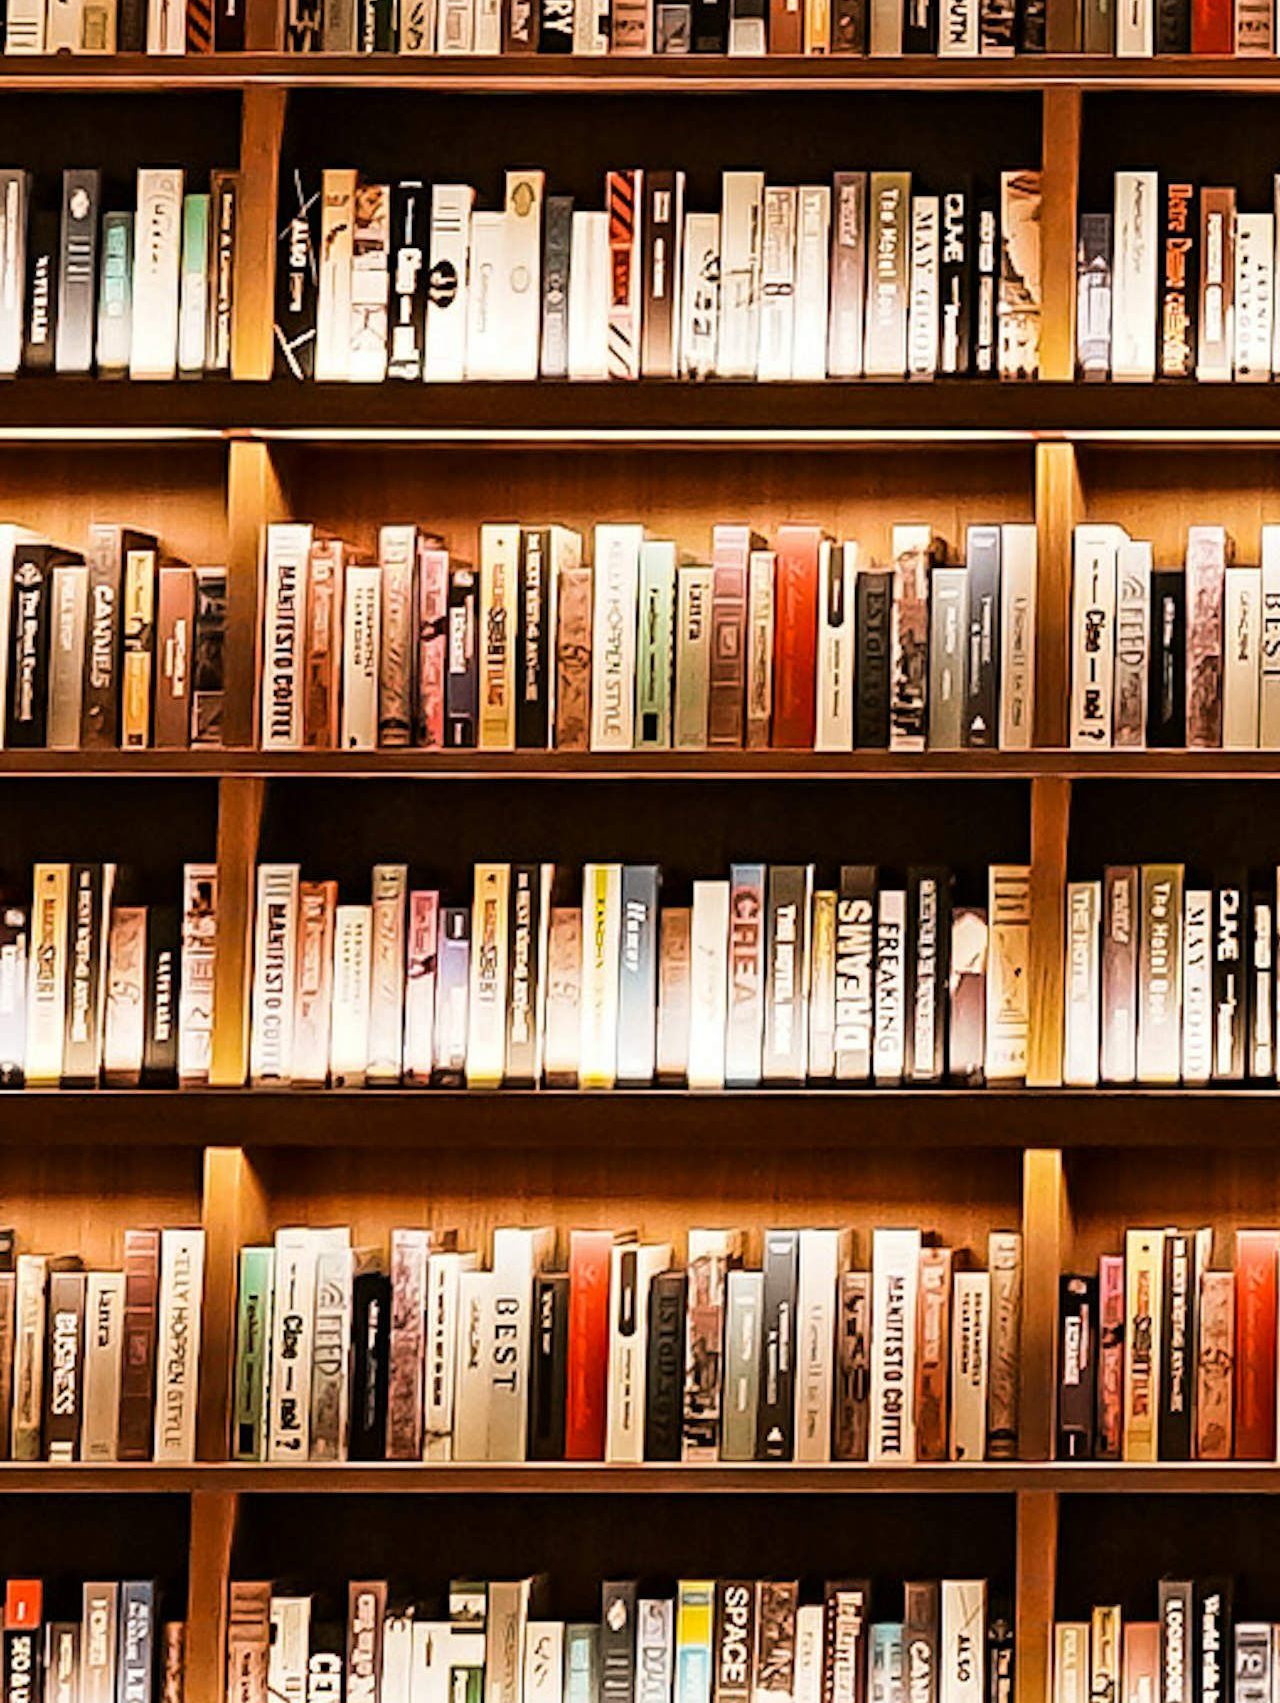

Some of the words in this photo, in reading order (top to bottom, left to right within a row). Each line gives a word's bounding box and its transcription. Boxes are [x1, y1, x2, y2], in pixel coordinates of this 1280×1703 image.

[91, 584, 112, 688] CANNES
[835, 900, 872, 1049] DREAMS
[878, 923, 900, 1052] FREAKING
[53, 1312, 76, 1414] BUSINESS
[492, 1298, 518, 1394] BEST
[723, 1588, 746, 1682] SPACE
